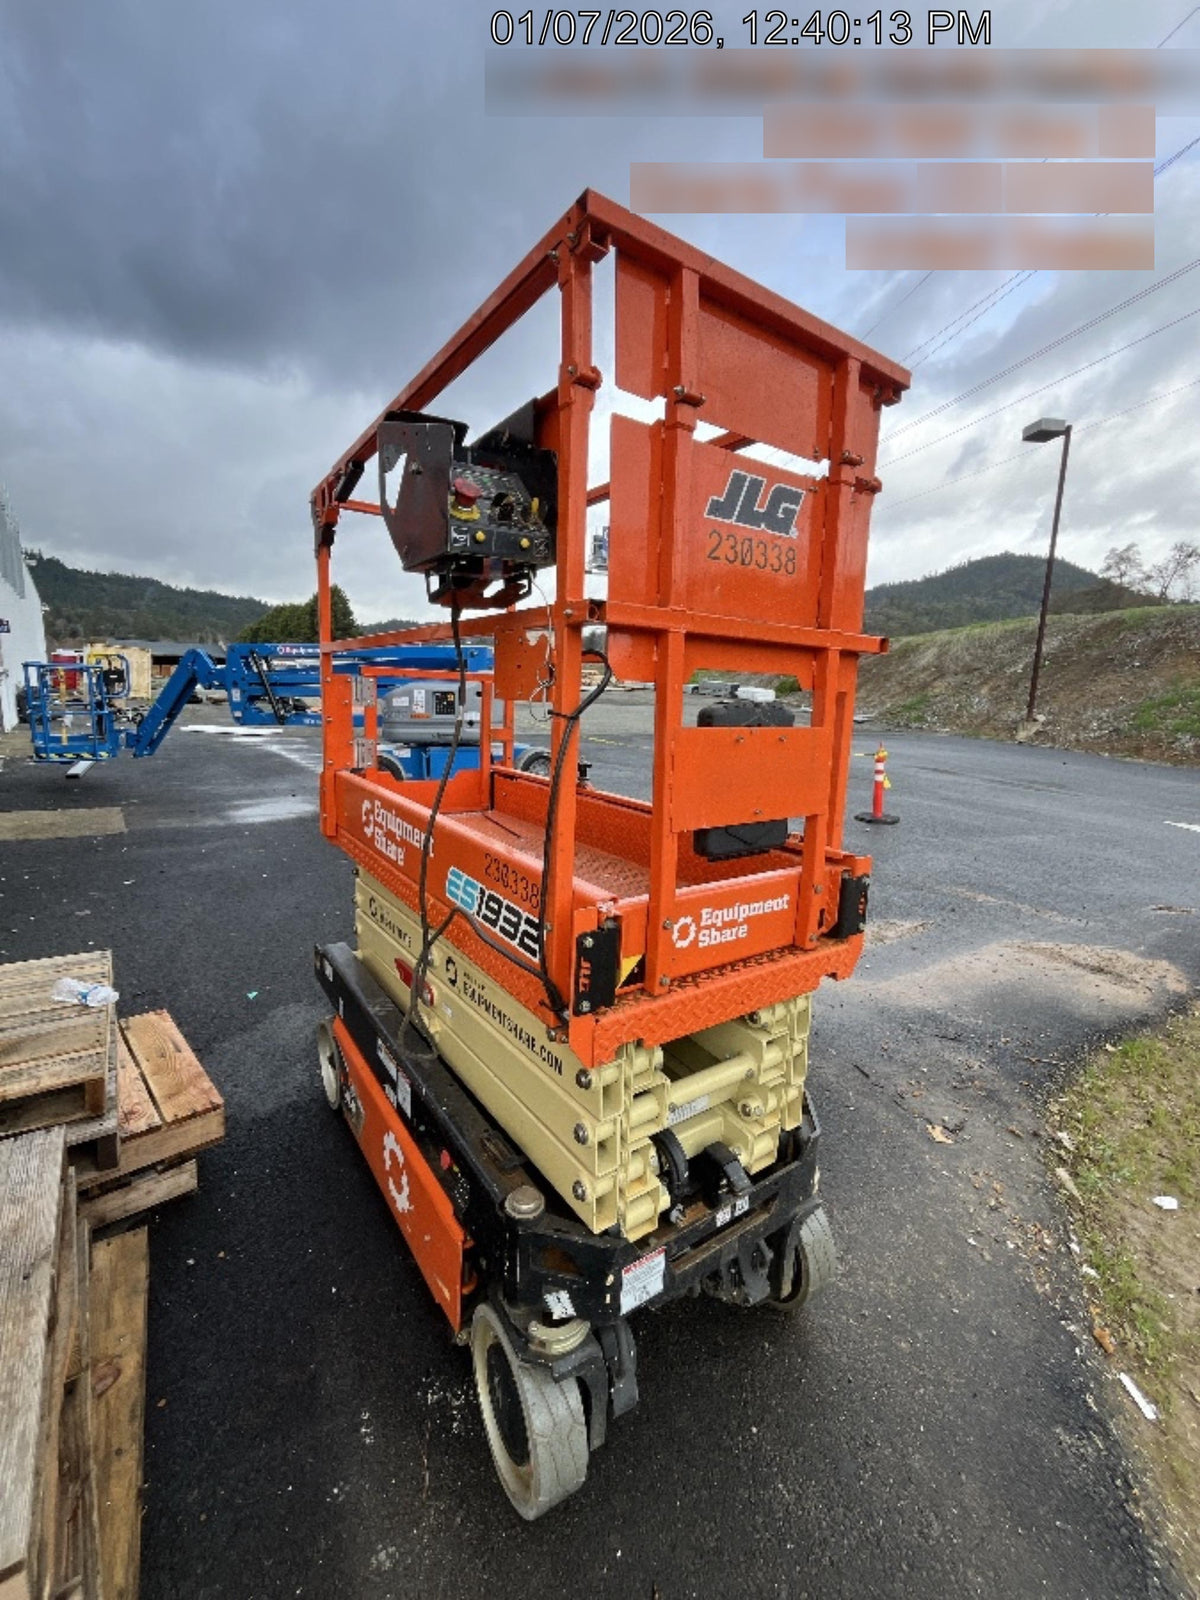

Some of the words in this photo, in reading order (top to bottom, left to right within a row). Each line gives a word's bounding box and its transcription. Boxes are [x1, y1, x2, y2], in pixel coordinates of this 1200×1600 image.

[704, 469, 806, 538] JLG
[707, 529, 796, 575] 230338
[374, 826, 405, 866] Share
[700, 893, 790, 927] Equipment
[698, 924, 748, 948] Share
